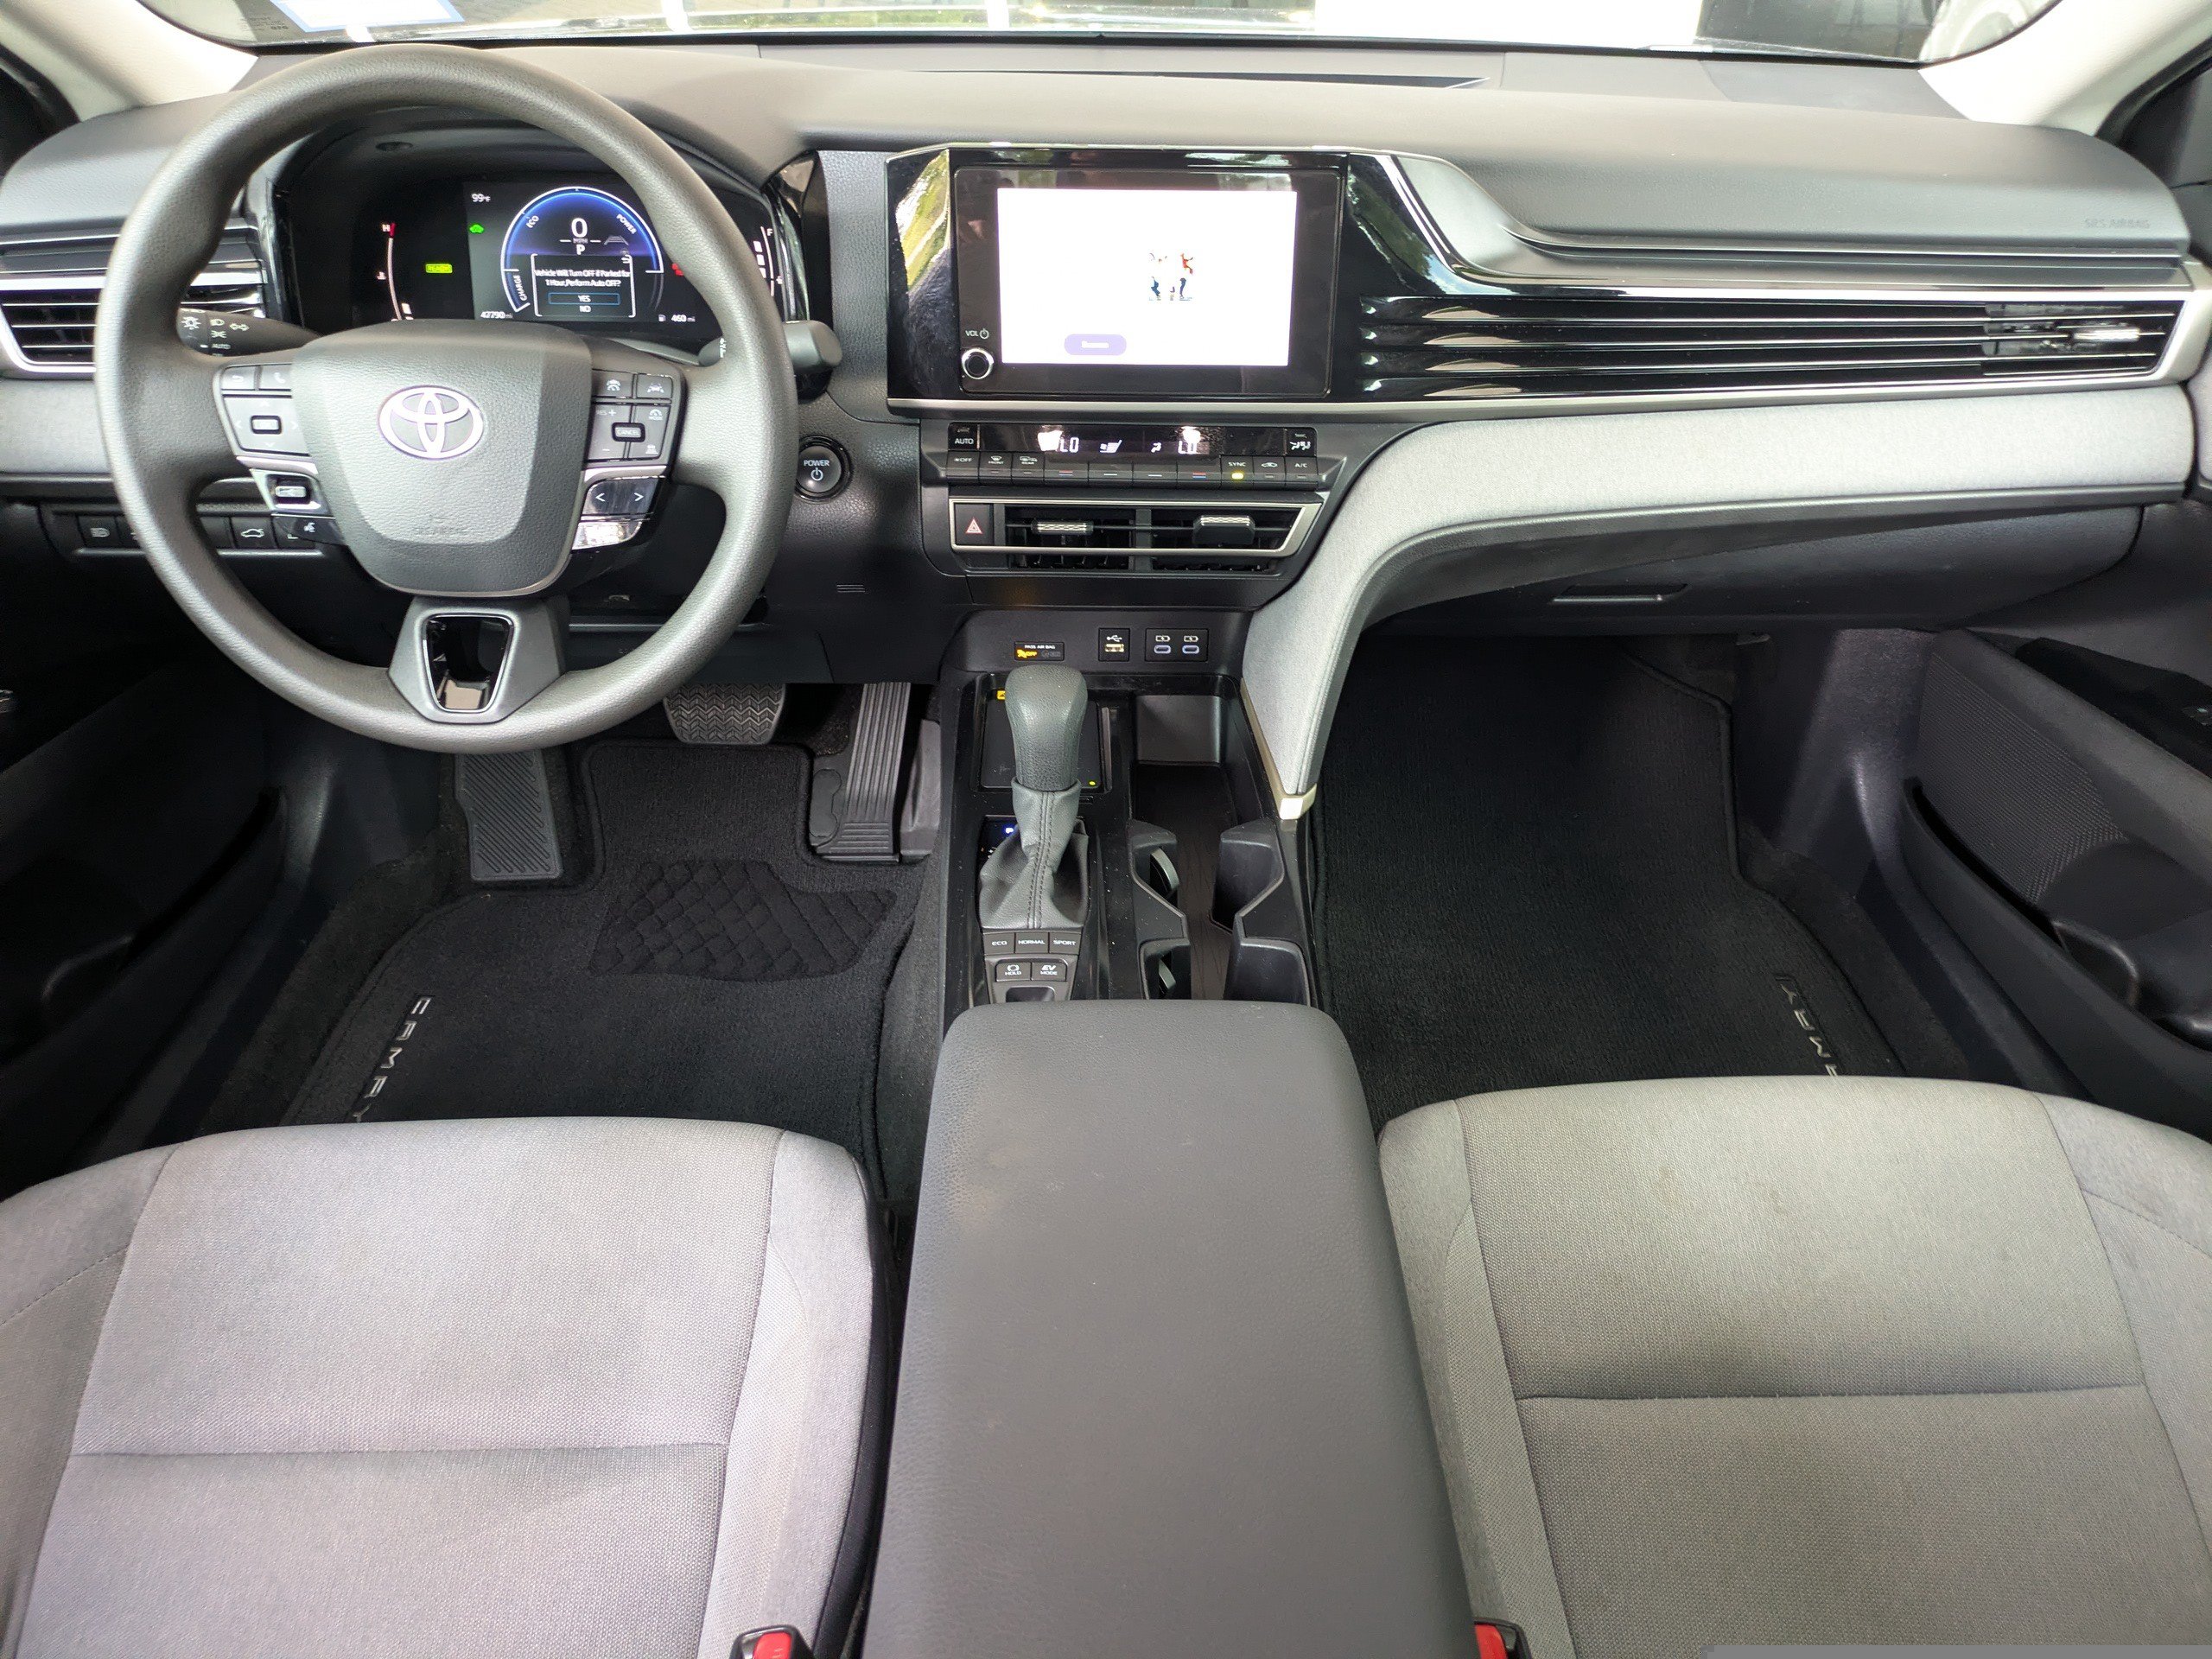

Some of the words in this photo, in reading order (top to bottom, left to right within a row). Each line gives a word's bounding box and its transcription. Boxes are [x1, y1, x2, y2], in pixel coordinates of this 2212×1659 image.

[525, 215, 539, 228] ECO
[571, 218, 588, 238] 0
[616, 213, 637, 234] POWER
[576, 244, 586, 256] P
[535, 269, 556, 277] Vehicle
[569, 269, 582, 277] Turn
[583, 269, 595, 277] OFF
[601, 269, 621, 277] Parked
[513, 274, 528, 302] CHARGE
[590, 278, 606, 287] Auto
[1060, 436, 1079, 453] LO
